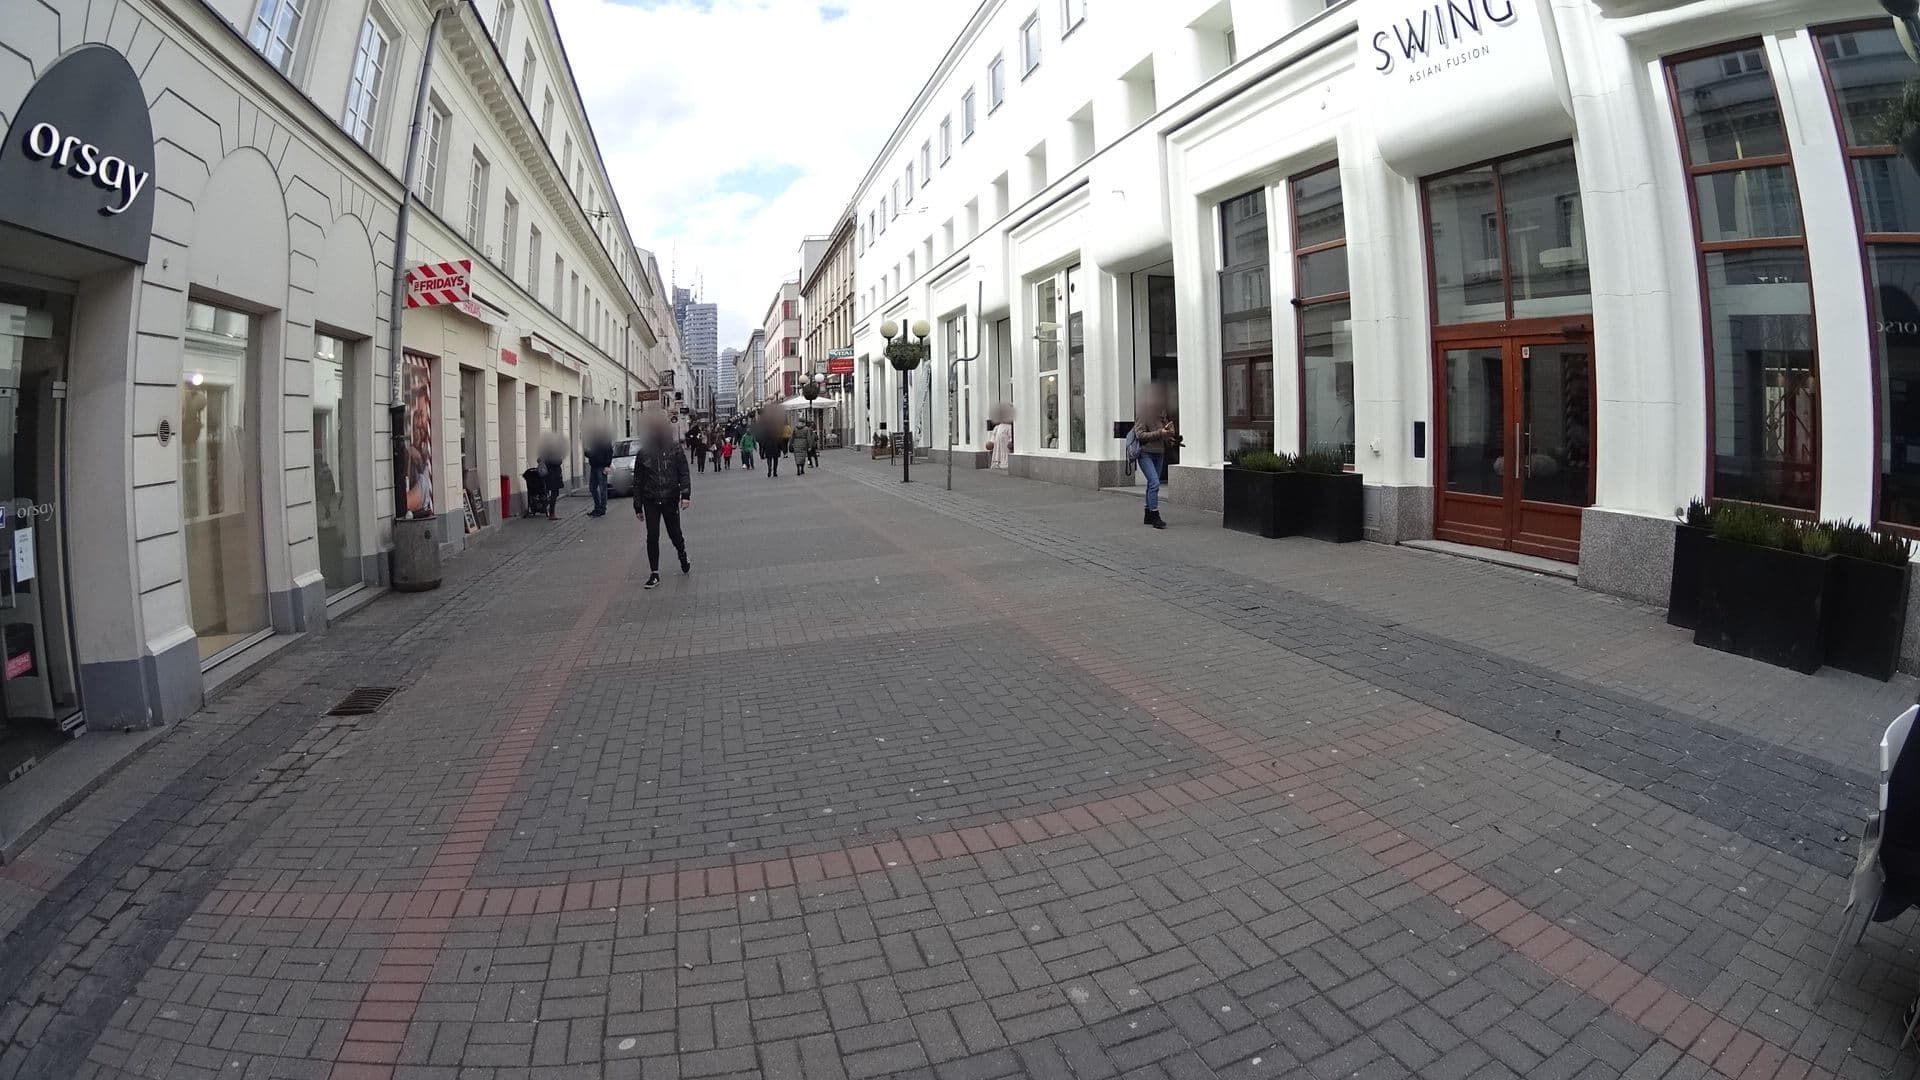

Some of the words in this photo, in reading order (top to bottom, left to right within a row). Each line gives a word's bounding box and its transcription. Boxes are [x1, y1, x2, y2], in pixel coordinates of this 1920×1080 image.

[1373, 0, 1513, 70] SWING
[1409, 63, 1442, 84] ASIAN
[1446, 45, 1490, 69] FUSION
[30, 122, 149, 213] orsay
[420, 276, 464, 291] FRIDAYS
[17, 502, 56, 521] orsay
